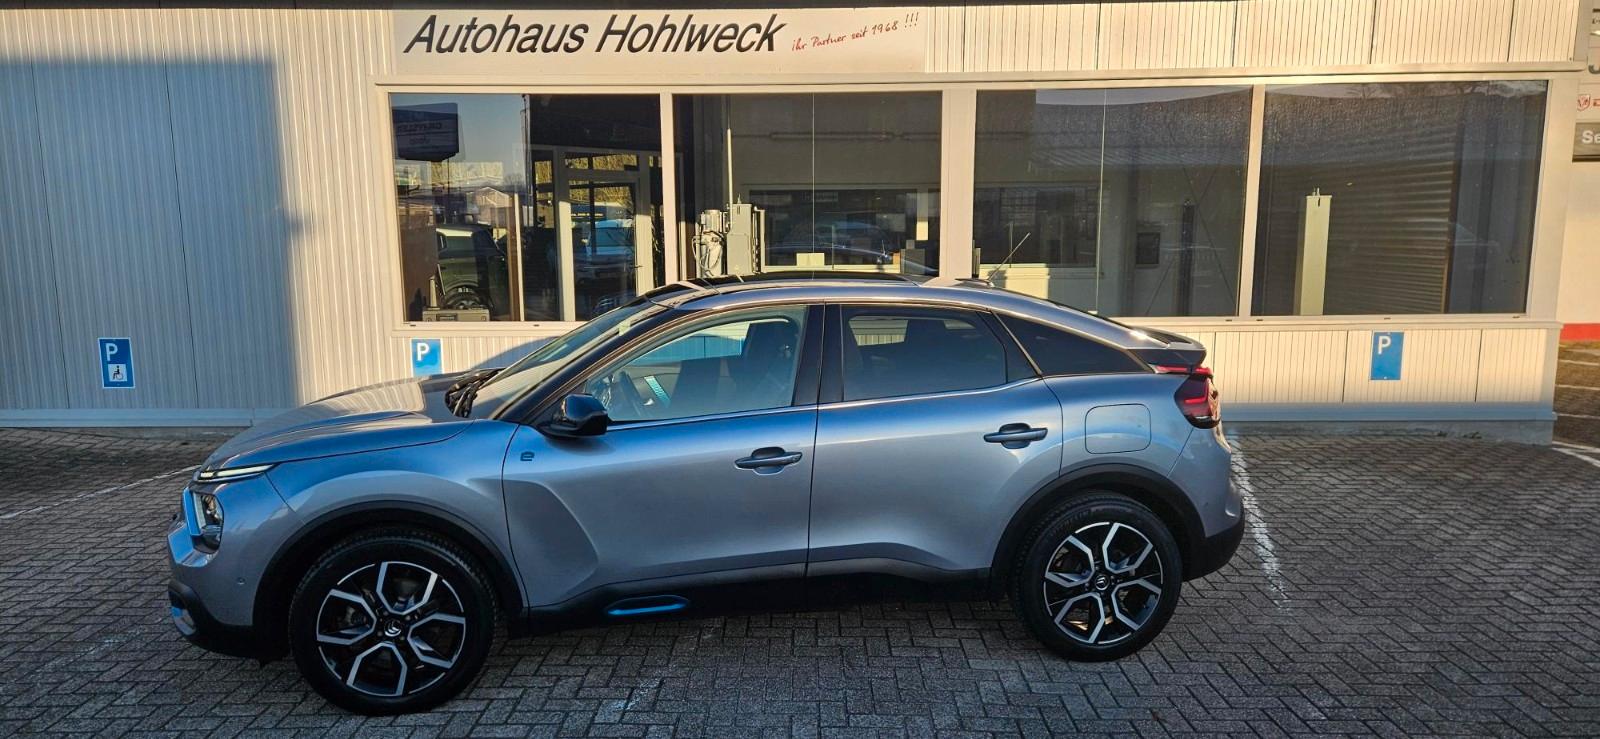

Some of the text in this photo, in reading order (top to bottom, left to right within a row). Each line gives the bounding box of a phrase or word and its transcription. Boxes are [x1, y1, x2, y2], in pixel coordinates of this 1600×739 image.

[403, 13, 787, 53] Autohaus Hohlweck
[811, 34, 847, 47] Partner
[851, 27, 868, 40] seit
[871, 20, 899, 35] 1968
[105, 342, 118, 361] P
[416, 342, 430, 361] P
[1378, 335, 1391, 355] P
